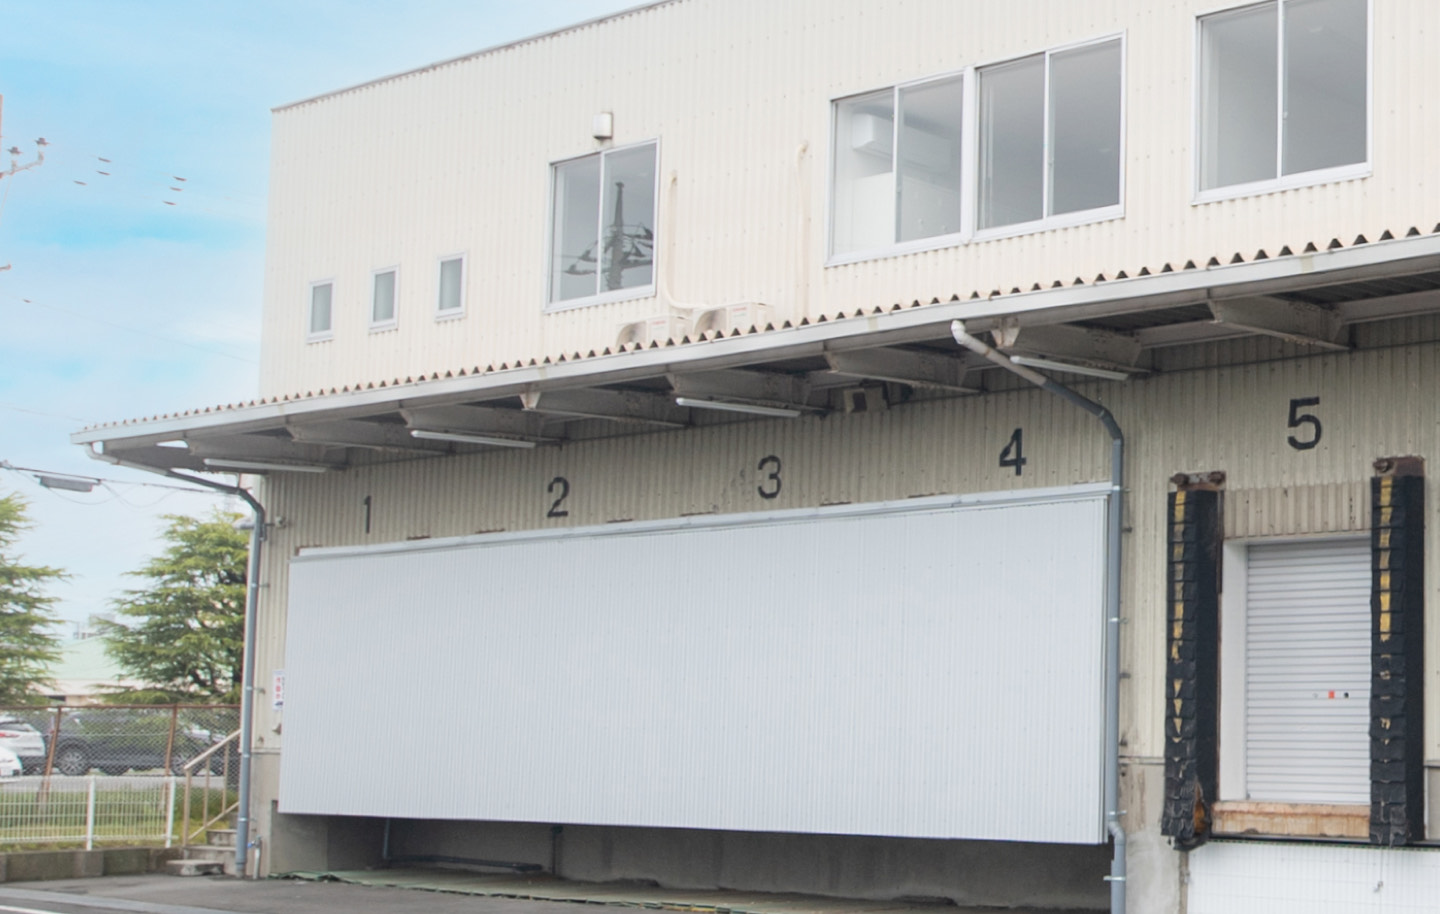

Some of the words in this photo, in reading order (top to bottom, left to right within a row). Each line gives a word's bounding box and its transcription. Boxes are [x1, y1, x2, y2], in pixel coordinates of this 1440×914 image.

[1287, 396, 1323, 451] 5
[998, 427, 1027, 477] 4
[547, 476, 570, 518] 2
[758, 455, 782, 499] 3
[363, 495, 372, 535] 1
